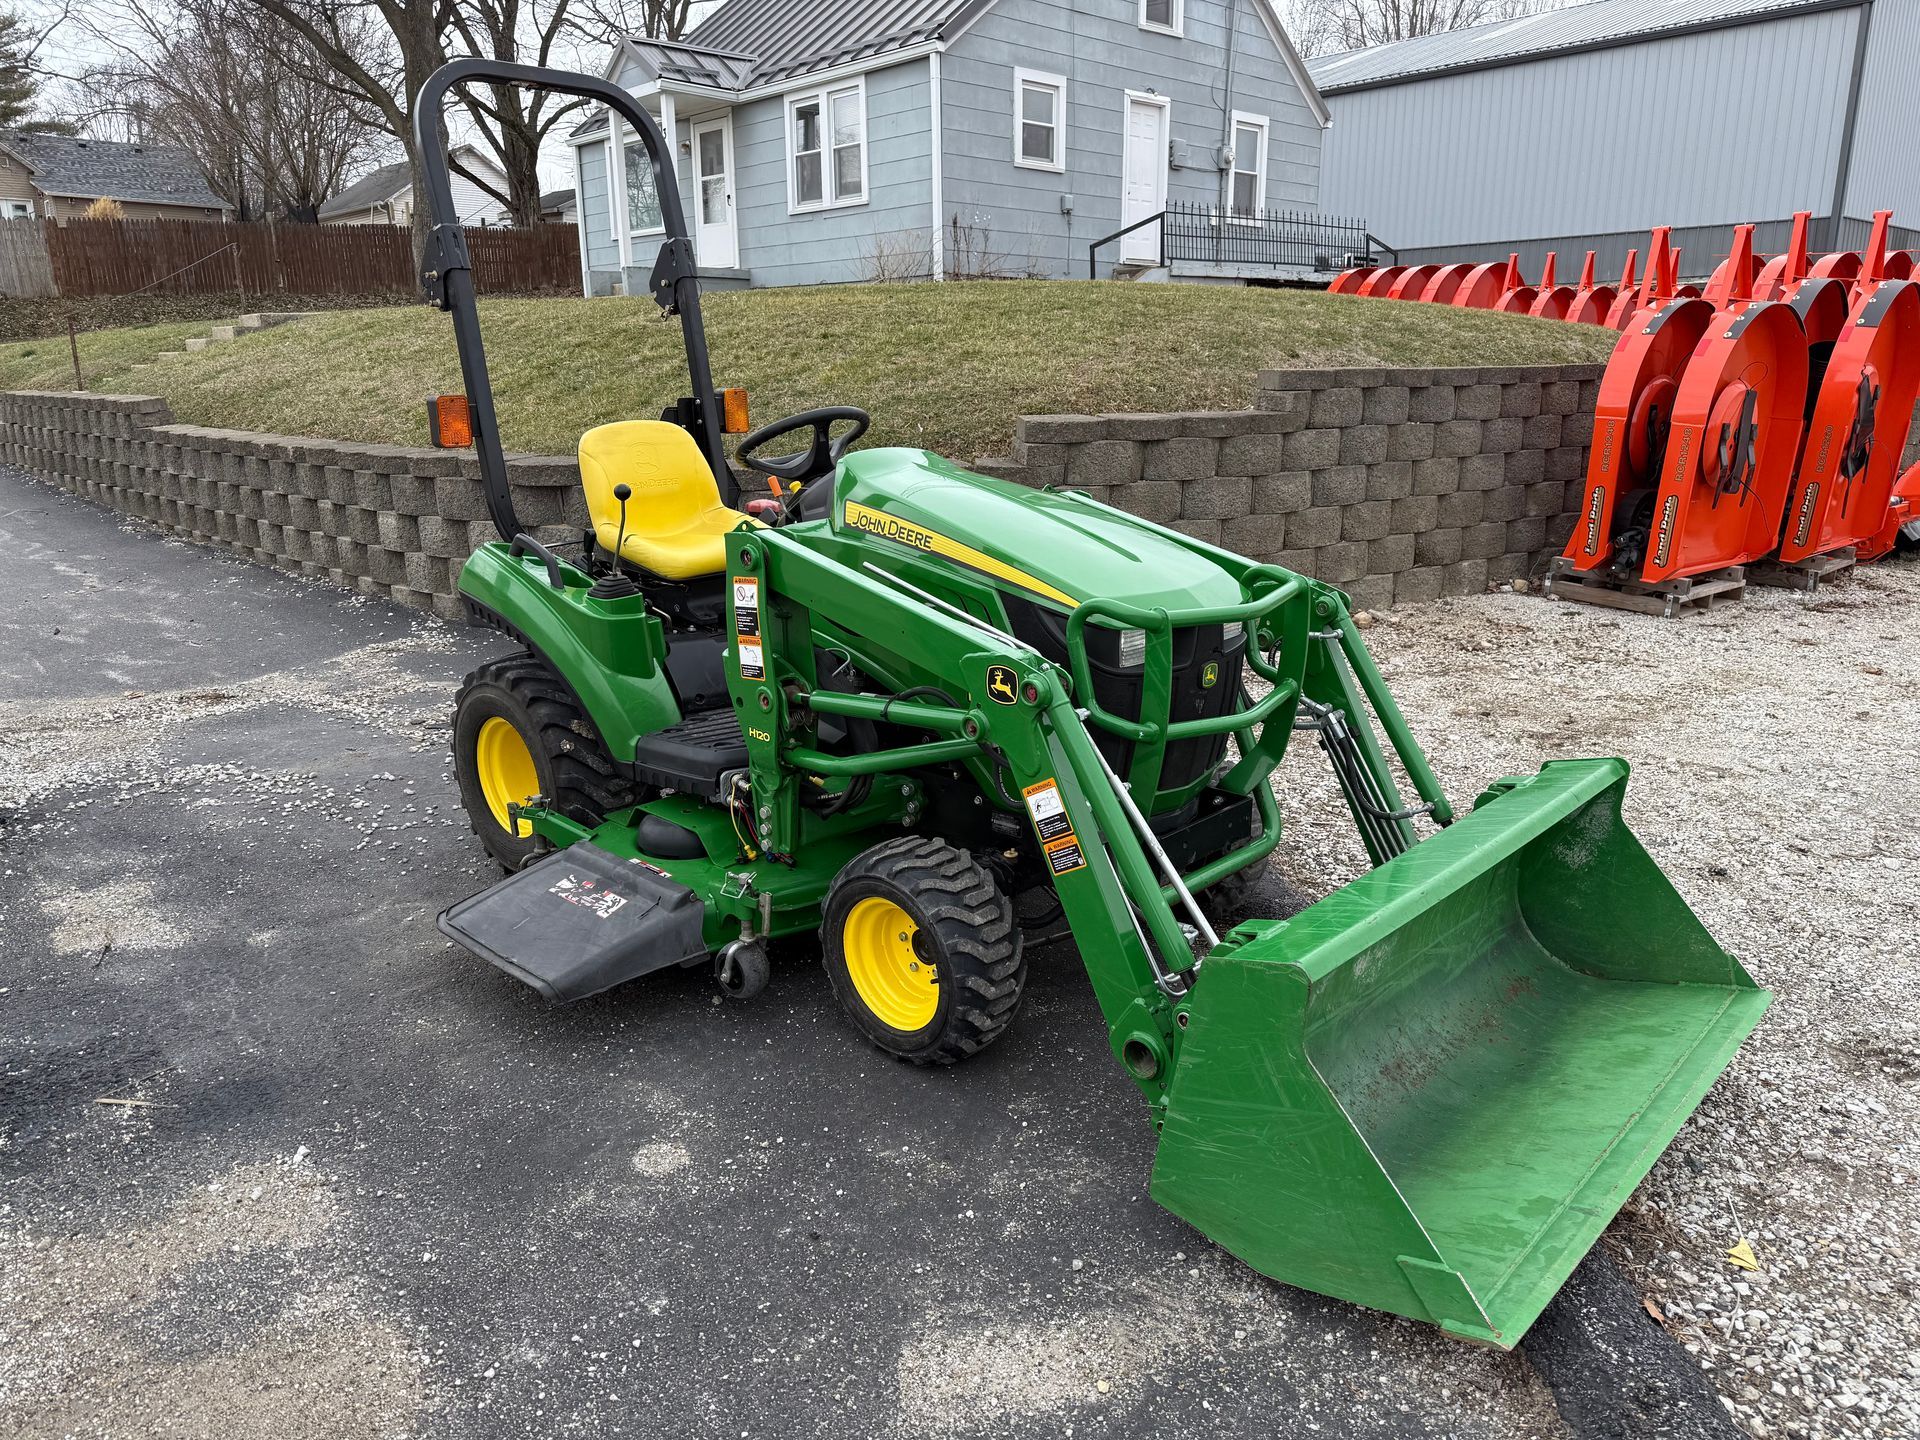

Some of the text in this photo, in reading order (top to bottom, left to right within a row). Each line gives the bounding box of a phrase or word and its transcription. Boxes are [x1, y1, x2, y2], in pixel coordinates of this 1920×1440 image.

[1602, 419, 1616, 472] RCR1248
[1675, 427, 1693, 482] RCR1248
[852, 511, 934, 549] JOHN DEERE
[1653, 496, 1673, 564] Land Pride
[1793, 482, 1815, 544] Land Pride
[749, 727, 771, 742] H120
[1031, 782, 1052, 792] WARNING
[1053, 838, 1074, 849] WARNING
